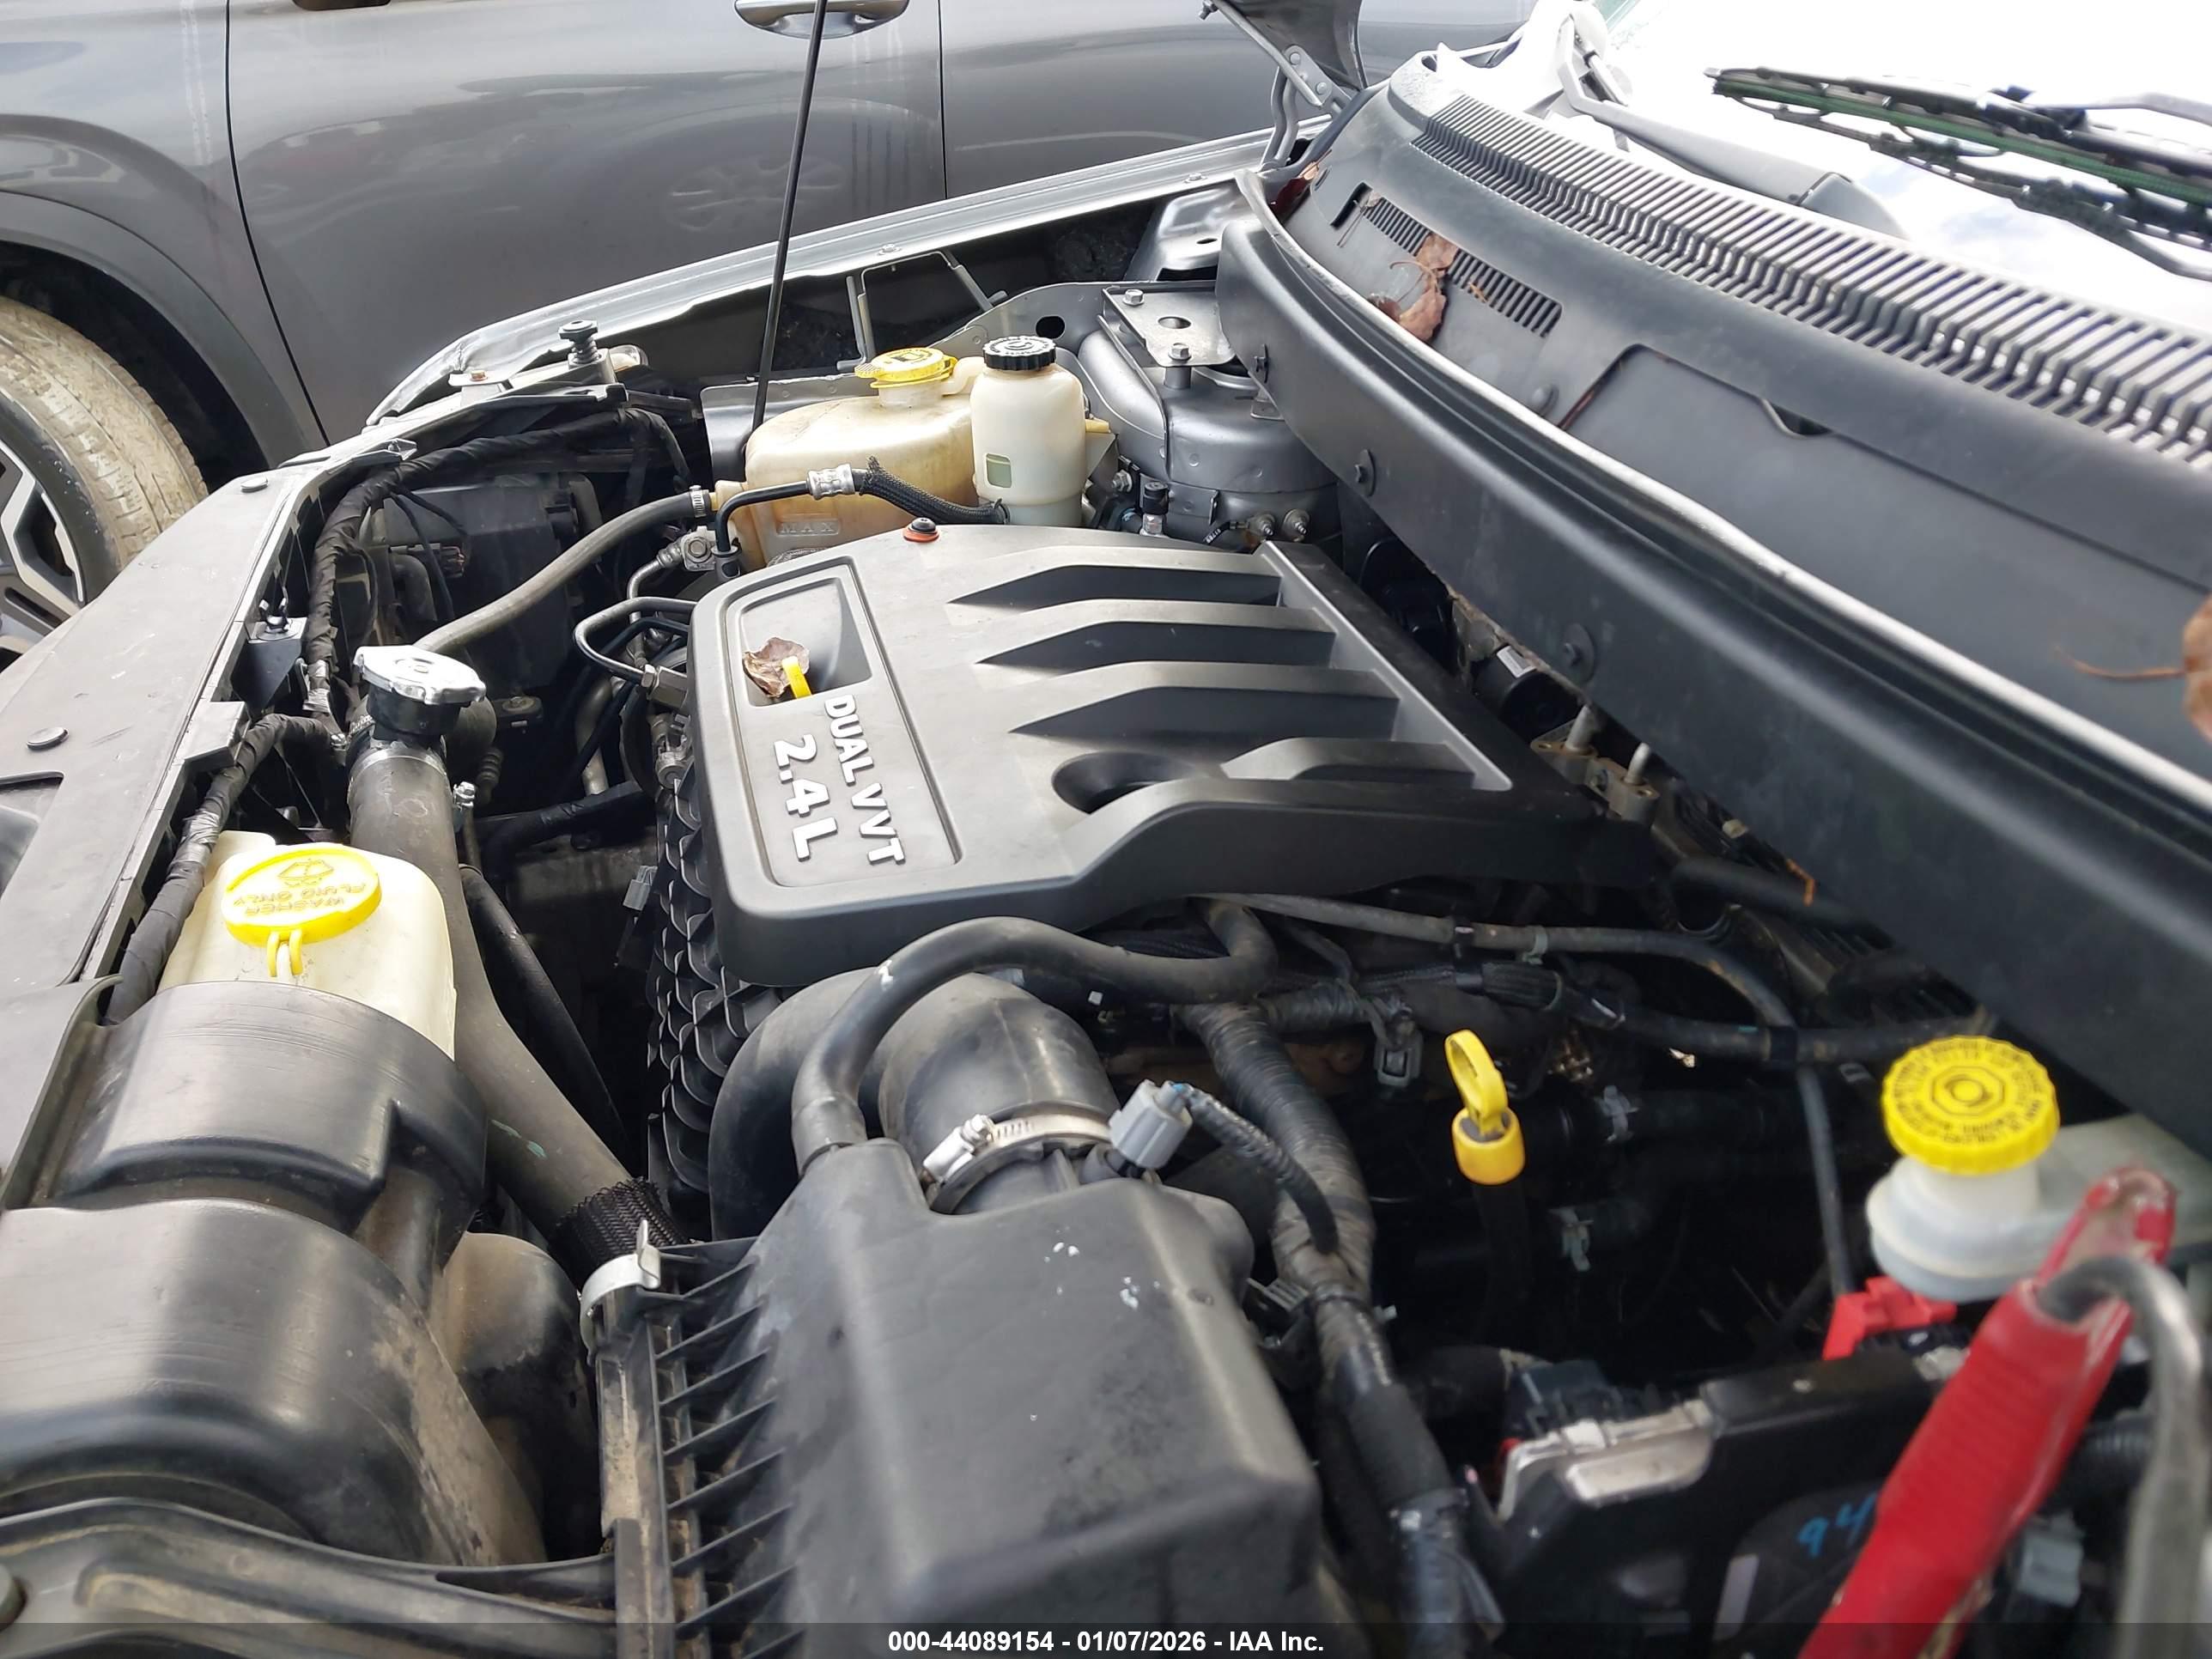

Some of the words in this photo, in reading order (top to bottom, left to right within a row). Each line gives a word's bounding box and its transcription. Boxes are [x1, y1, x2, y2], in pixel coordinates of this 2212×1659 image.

[780, 521, 835, 533] MAX
[824, 694, 874, 786] DUAL
[851, 782, 906, 866] VVT
[774, 734, 838, 862] 2.4L
[234, 890, 293, 906] ONLY
[301, 884, 366, 897] FLUID
[246, 898, 345, 915] WASHER
